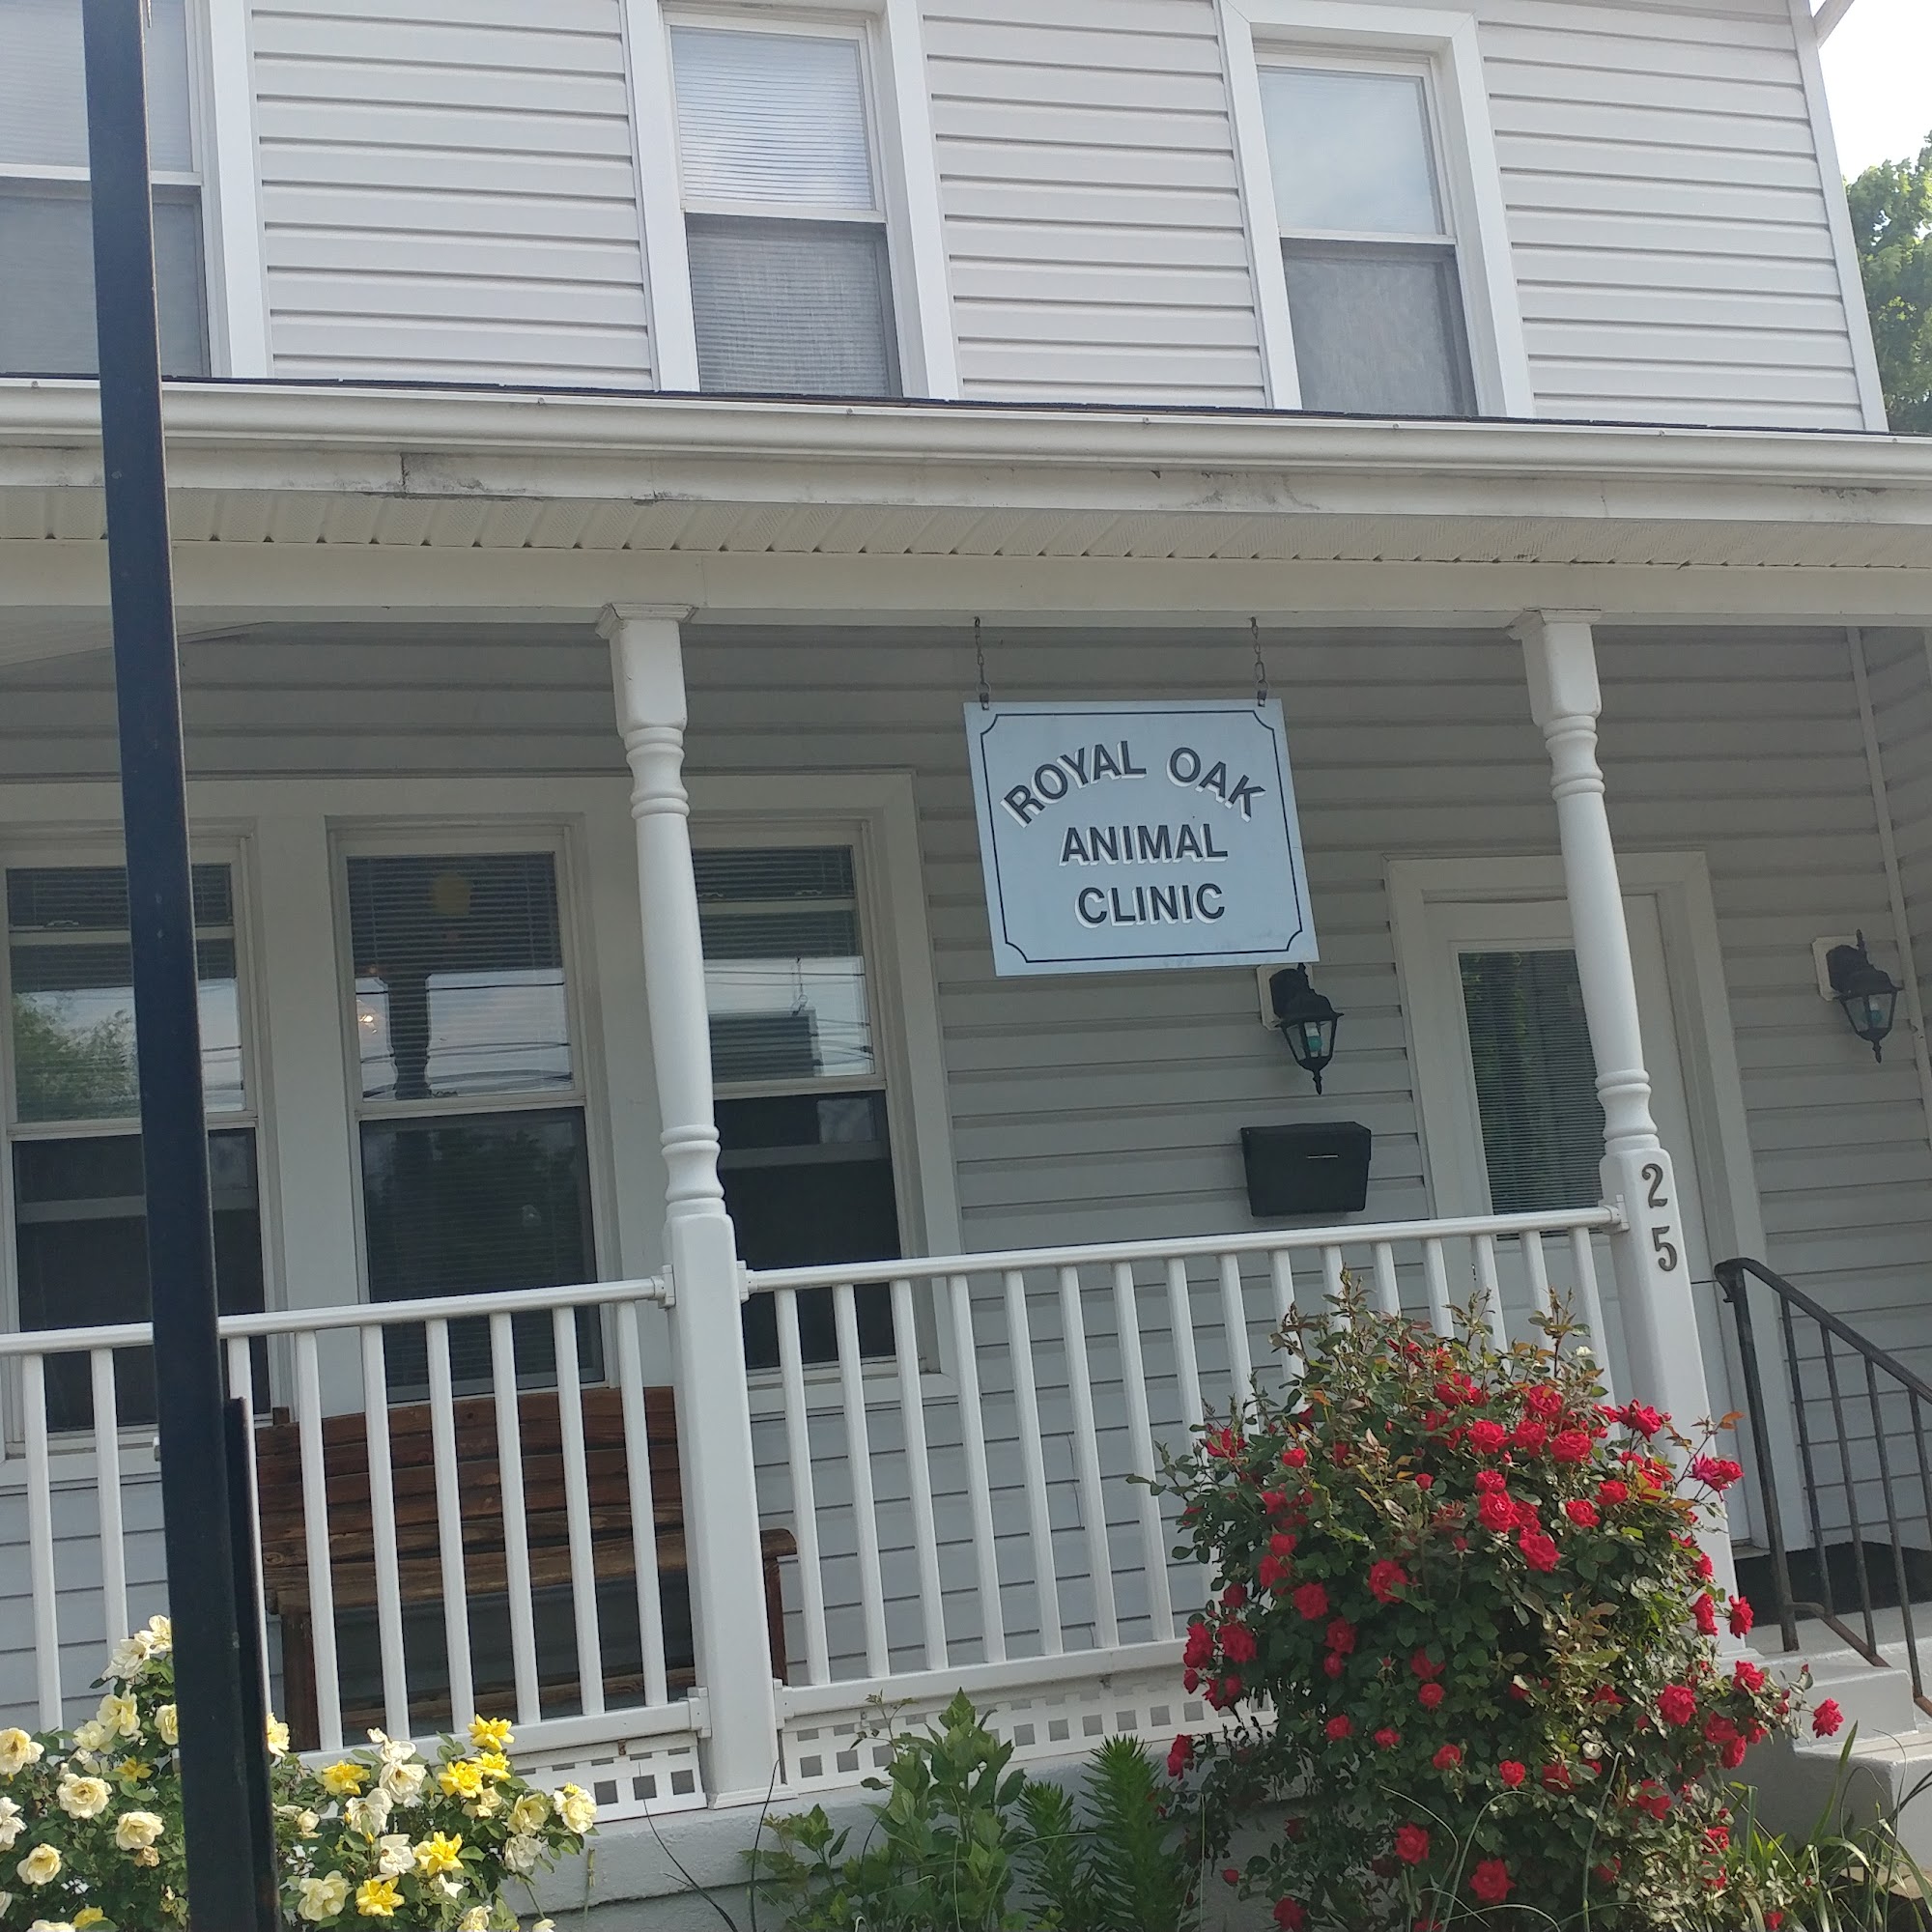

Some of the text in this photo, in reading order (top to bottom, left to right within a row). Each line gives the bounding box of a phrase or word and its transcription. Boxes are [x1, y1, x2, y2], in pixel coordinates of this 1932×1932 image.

[1001, 740, 1265, 827] ROYAL OAK
[1060, 823, 1228, 866] ANIMAL
[1075, 883, 1225, 927] CLINIC
